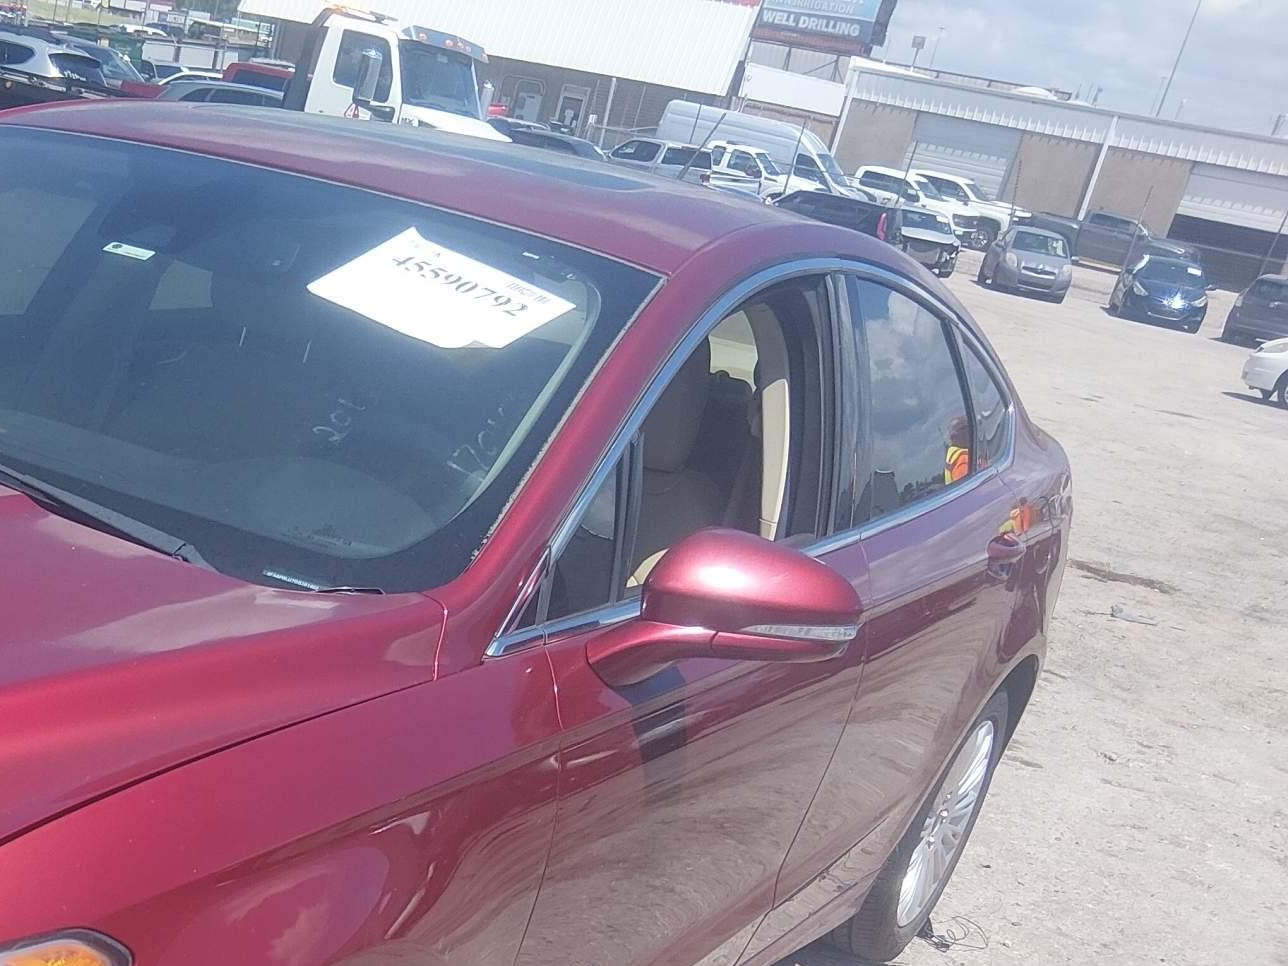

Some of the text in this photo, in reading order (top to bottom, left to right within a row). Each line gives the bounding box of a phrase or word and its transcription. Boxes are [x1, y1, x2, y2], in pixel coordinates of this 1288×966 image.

[762, 9, 861, 37] WELL DRILLING
[392, 255, 529, 317] 45590792
